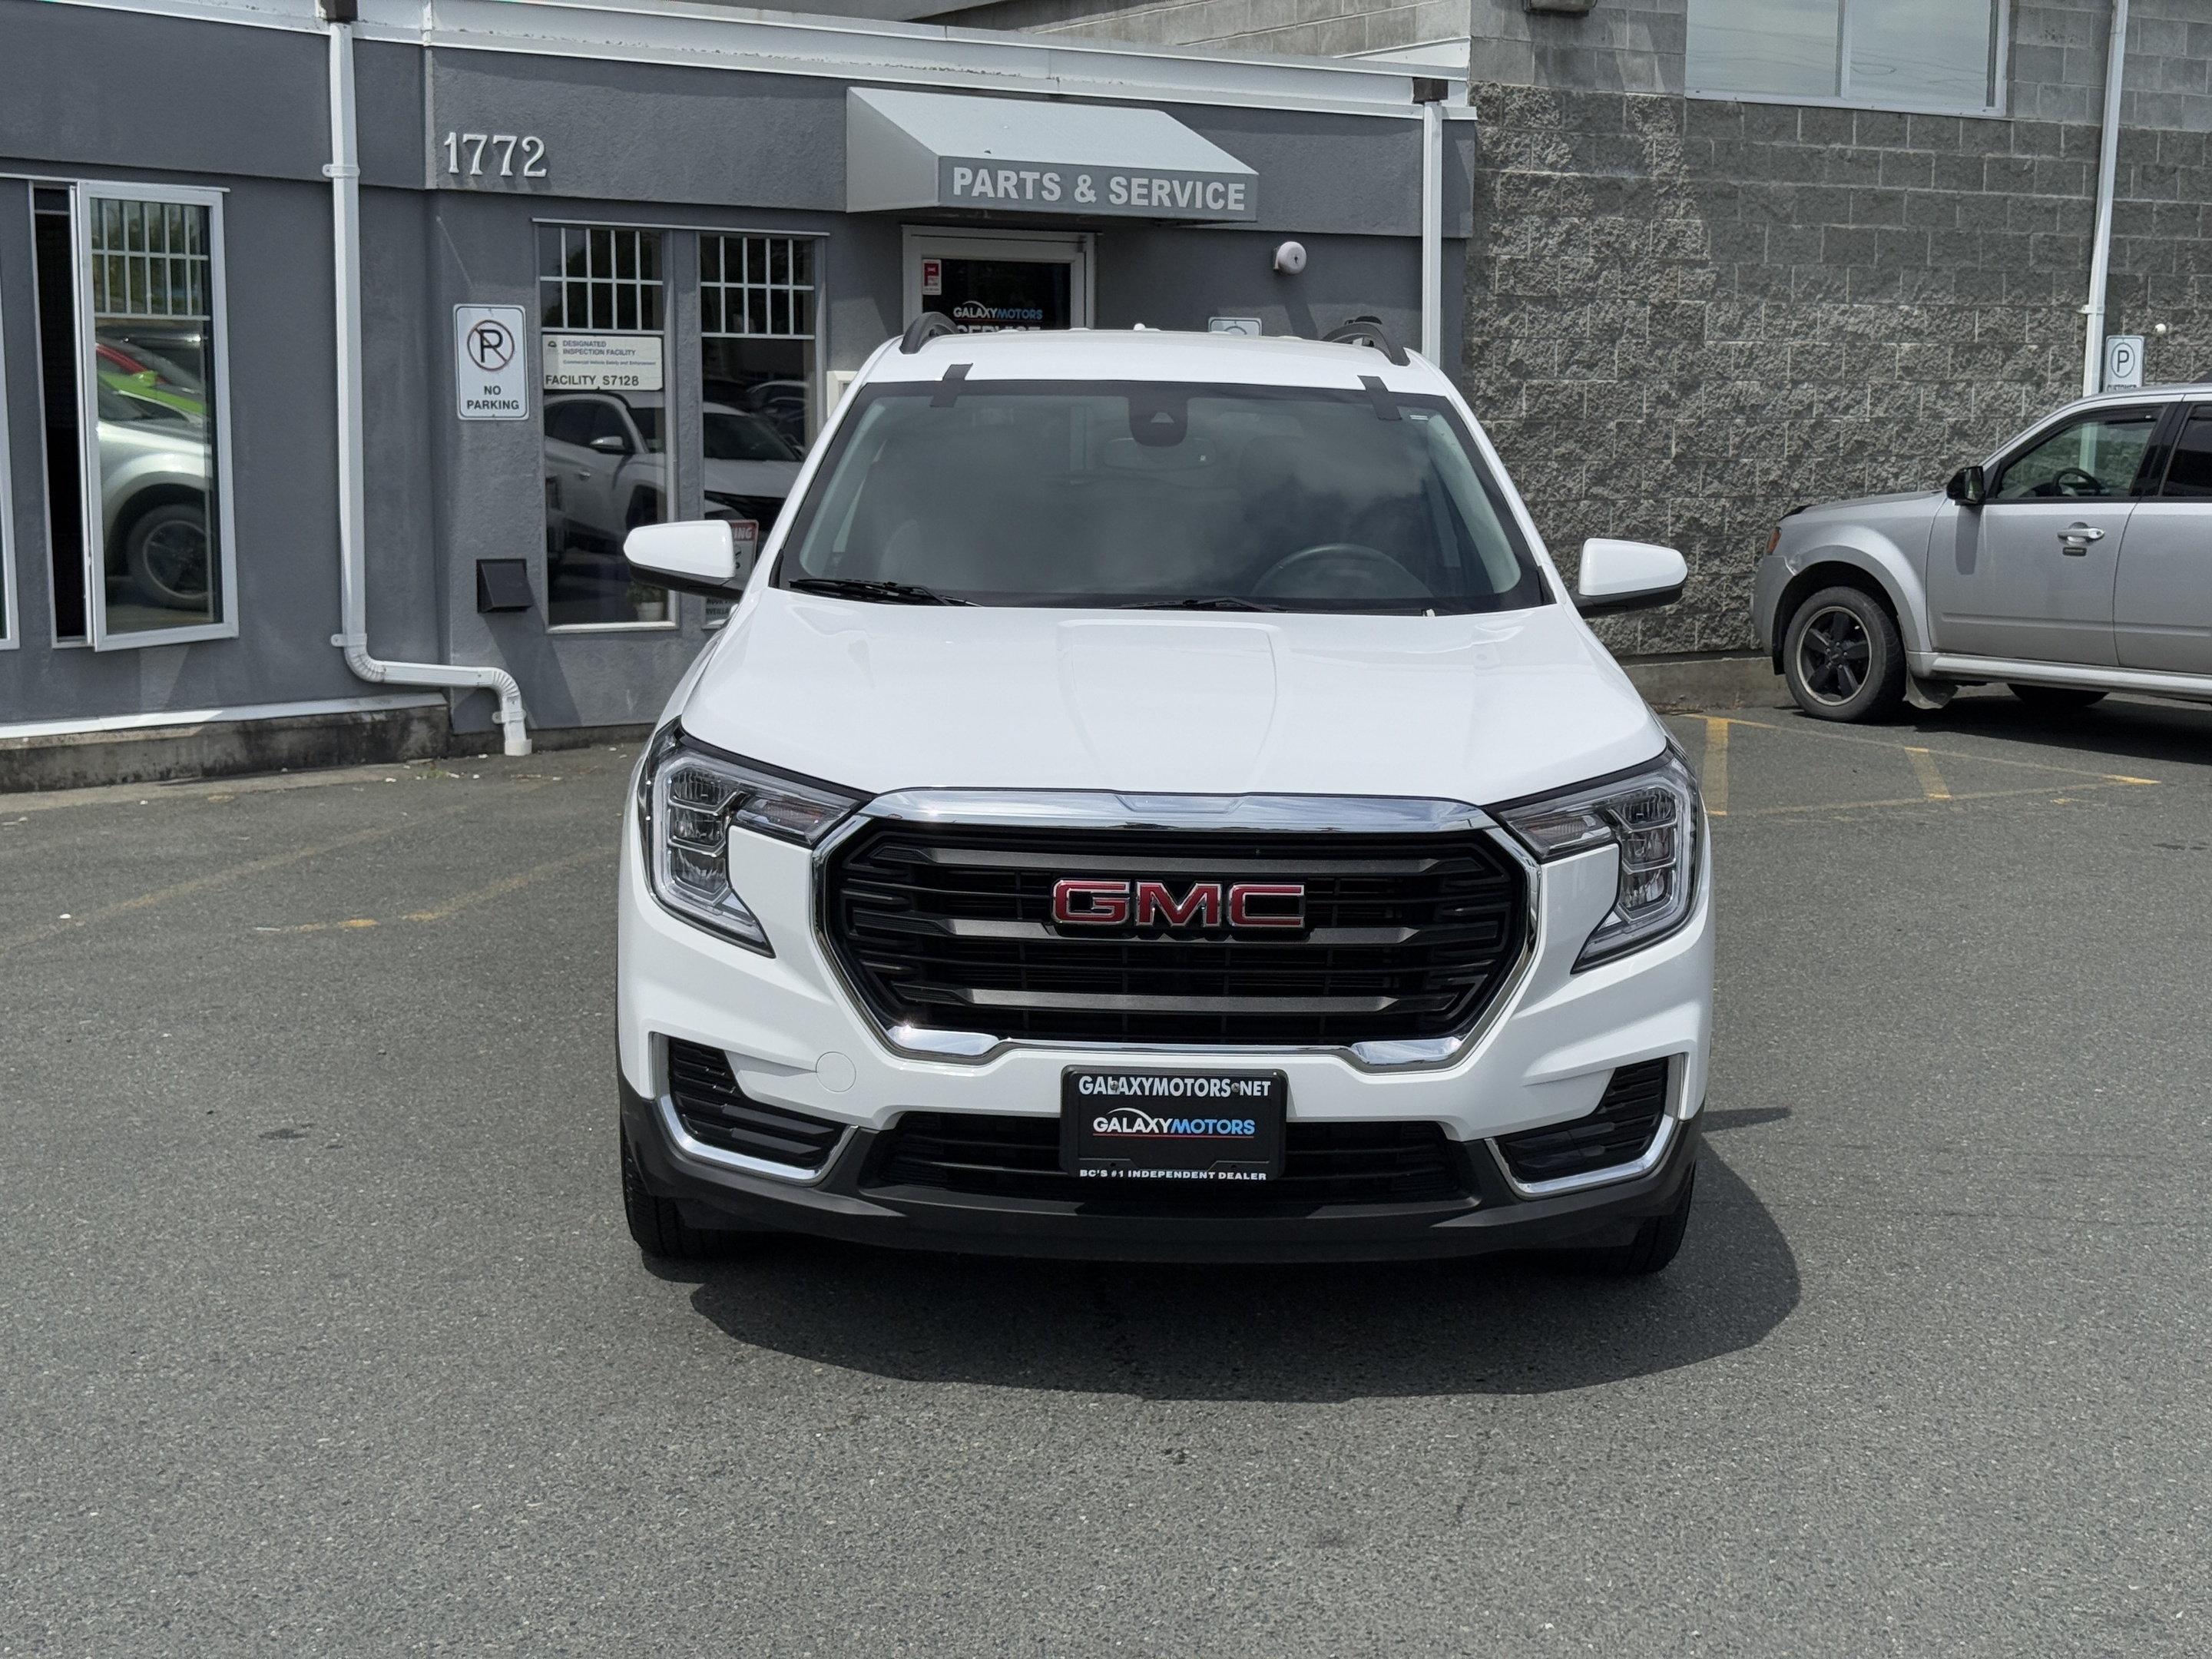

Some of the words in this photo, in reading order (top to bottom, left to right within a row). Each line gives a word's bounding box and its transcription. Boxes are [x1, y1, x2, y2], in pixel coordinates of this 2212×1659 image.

[444, 132, 547, 177] 1772
[953, 167, 1061, 202] PARTS
[1075, 174, 1097, 204] &
[1108, 176, 1246, 211] SERVICE
[953, 306, 1043, 320] GALAXYMOTORS
[562, 339, 607, 348] DESIGNATED
[545, 374, 597, 386] FACILITY
[602, 375, 640, 386] S7128
[483, 385, 502, 396] NO
[467, 399, 519, 410] PARKING
[1052, 878, 1305, 929] GMC
[1093, 1117, 1255, 1135] GALAXYMOTORS
[1079, 1169, 1108, 1177] BC'S
[1111, 1170, 1124, 1178] #1
[1128, 1170, 1215, 1180] INDEPENDENT
[1218, 1172, 1267, 1181] DEALER
